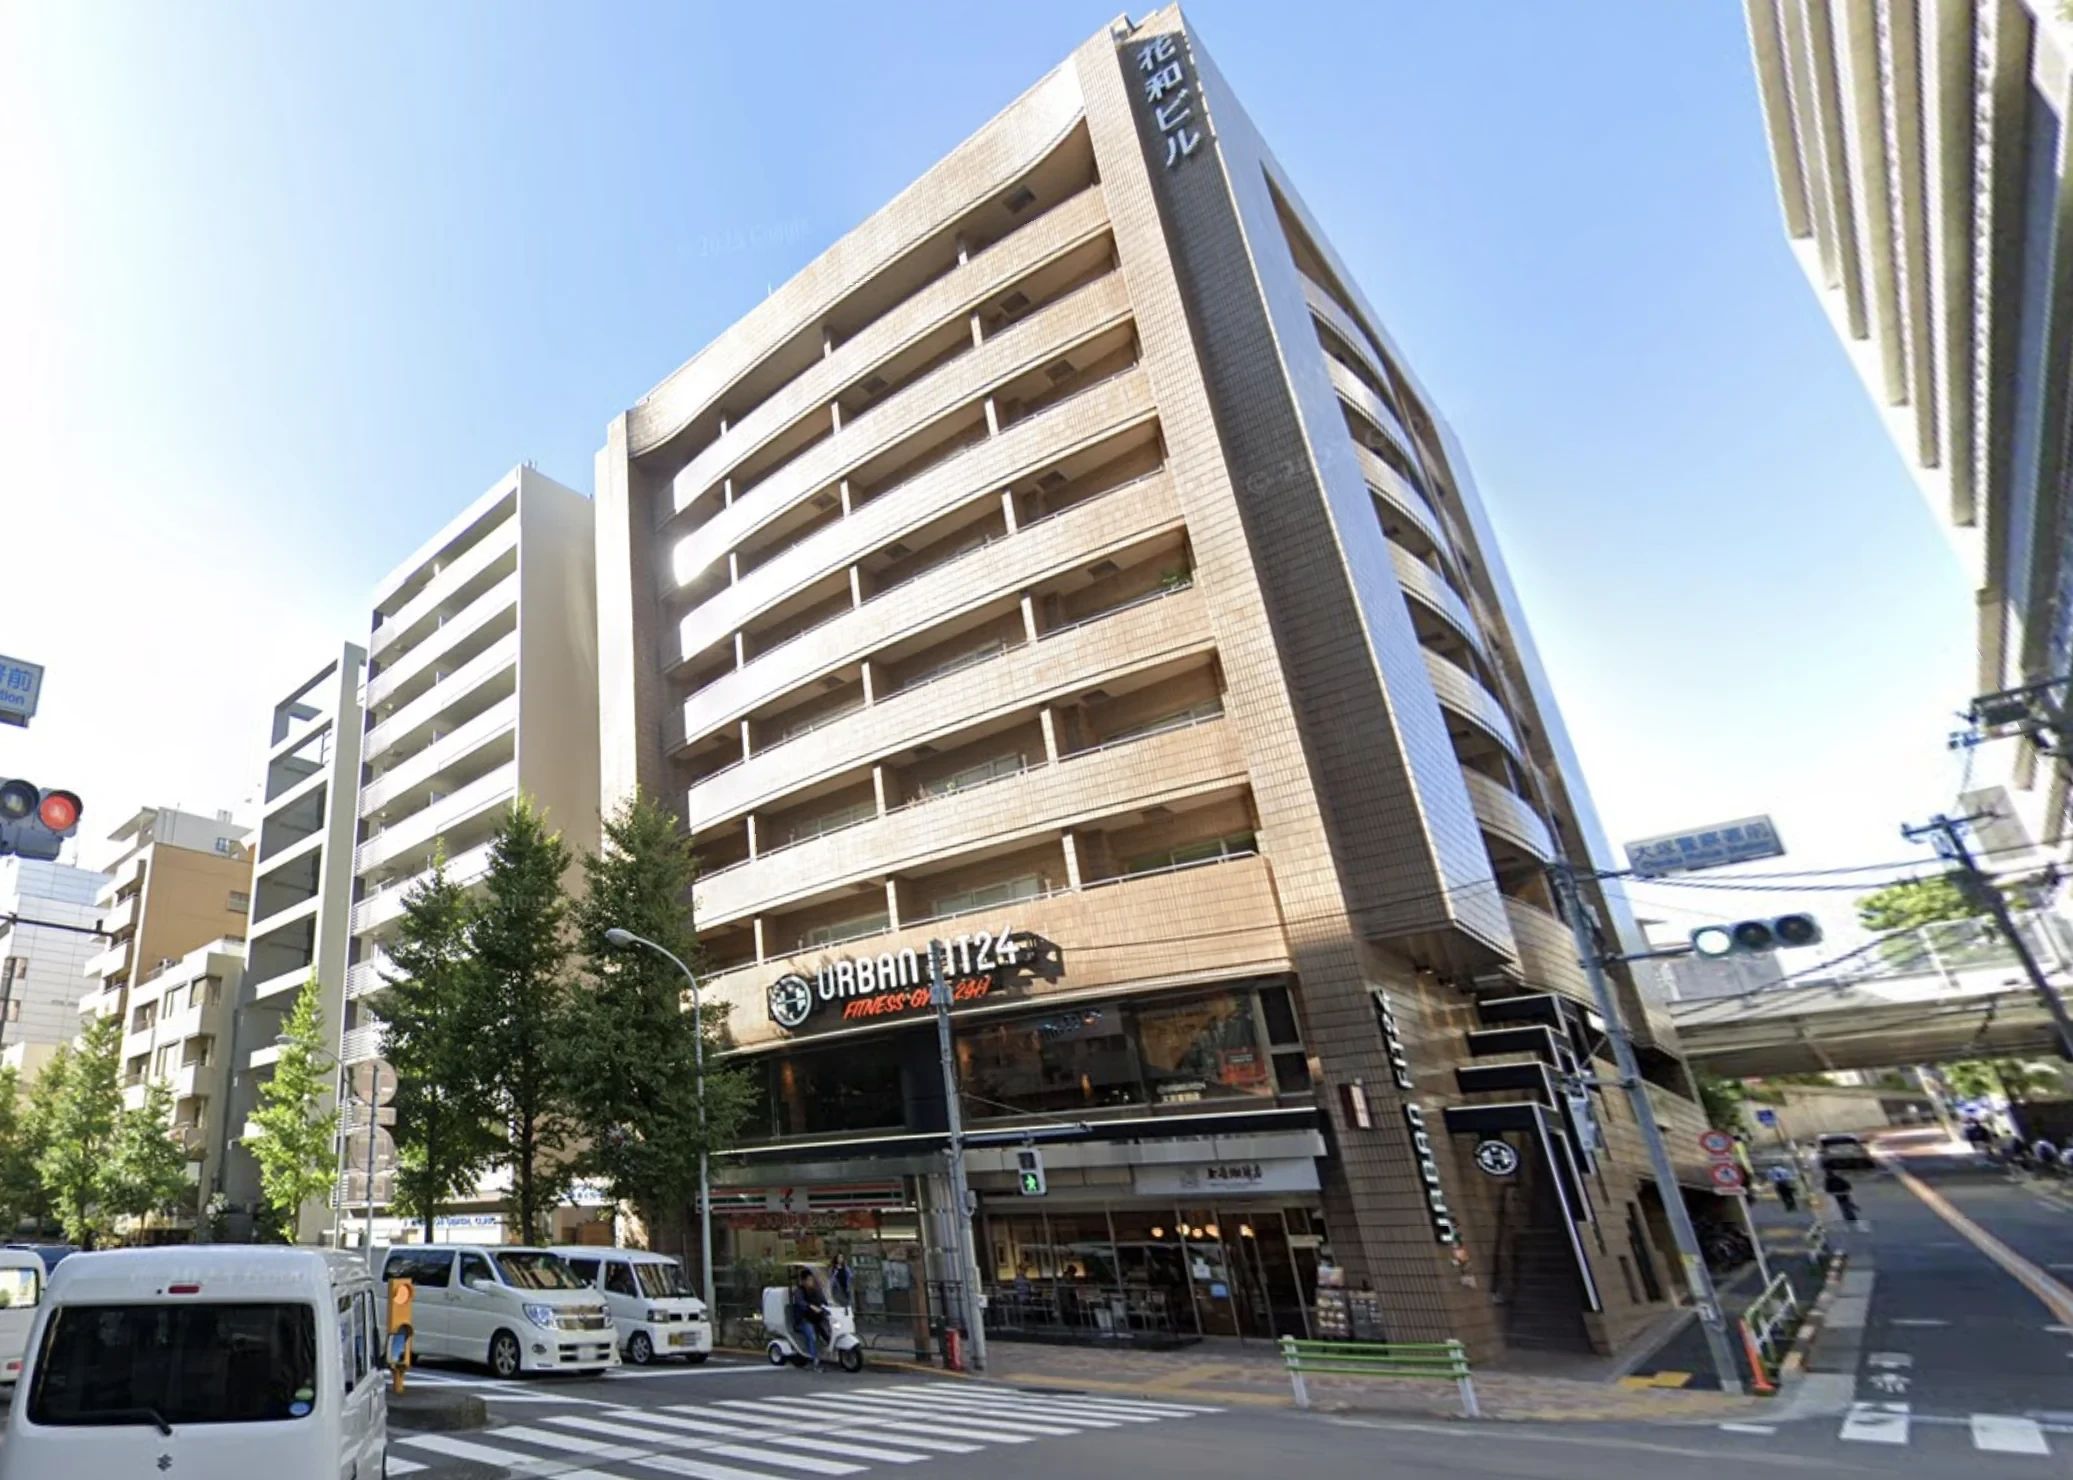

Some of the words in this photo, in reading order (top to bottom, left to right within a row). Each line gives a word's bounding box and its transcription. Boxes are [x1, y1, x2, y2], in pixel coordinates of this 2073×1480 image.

[1136, 33, 1201, 169] 花和ビル
[816, 946, 920, 1001] URBAN
[843, 992, 907, 1020] FITNESS
